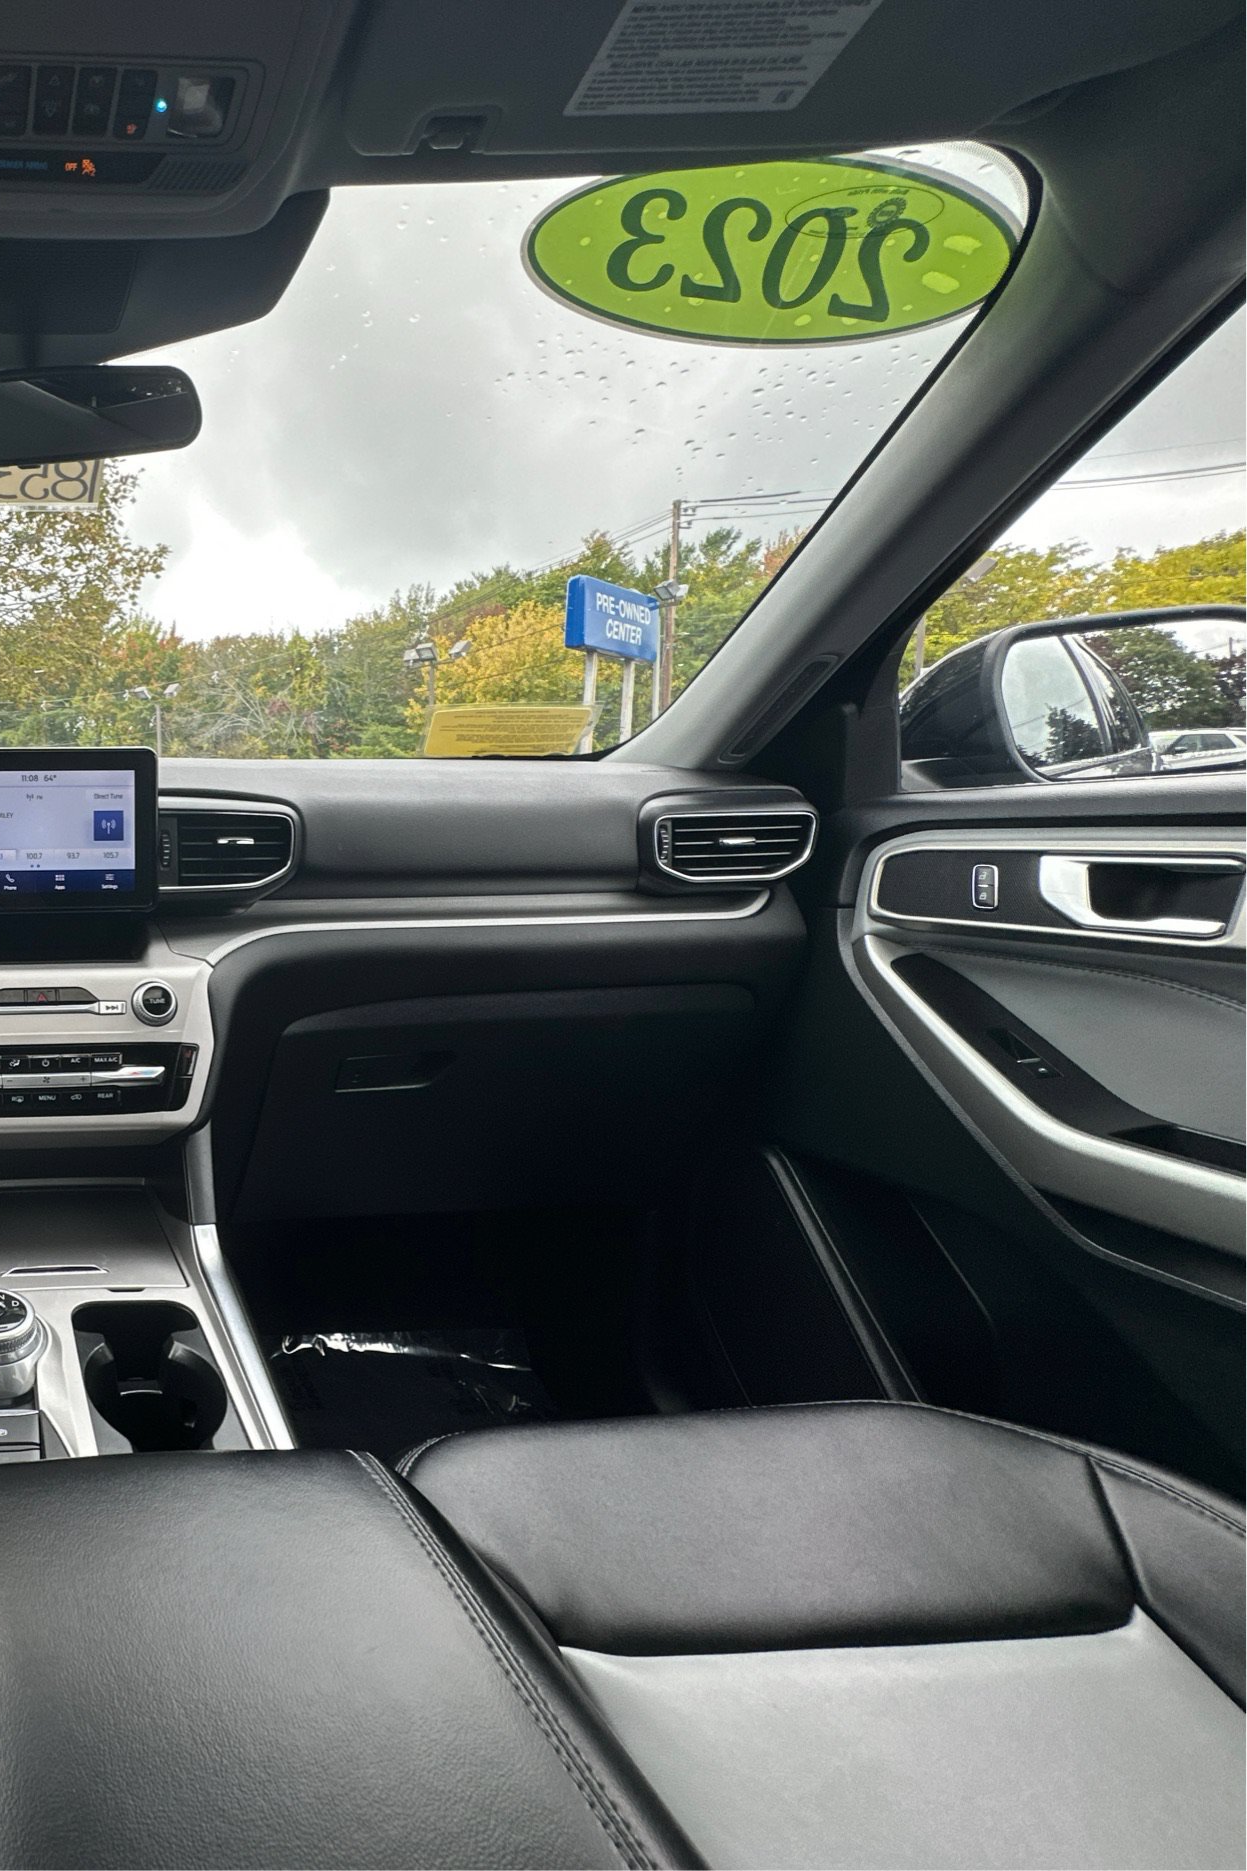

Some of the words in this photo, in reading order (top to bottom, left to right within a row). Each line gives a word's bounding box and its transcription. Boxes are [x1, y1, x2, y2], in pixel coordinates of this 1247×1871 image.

[65, 162, 77, 171] OFF
[596, 592, 651, 625] PRE-OWNED
[605, 618, 642, 645] CENTER
[21, 774, 39, 782] 11:08
[70, 1056, 81, 1064] A/C
[94, 1056, 107, 1064] MAX
[38, 1094, 56, 1102] MENU
